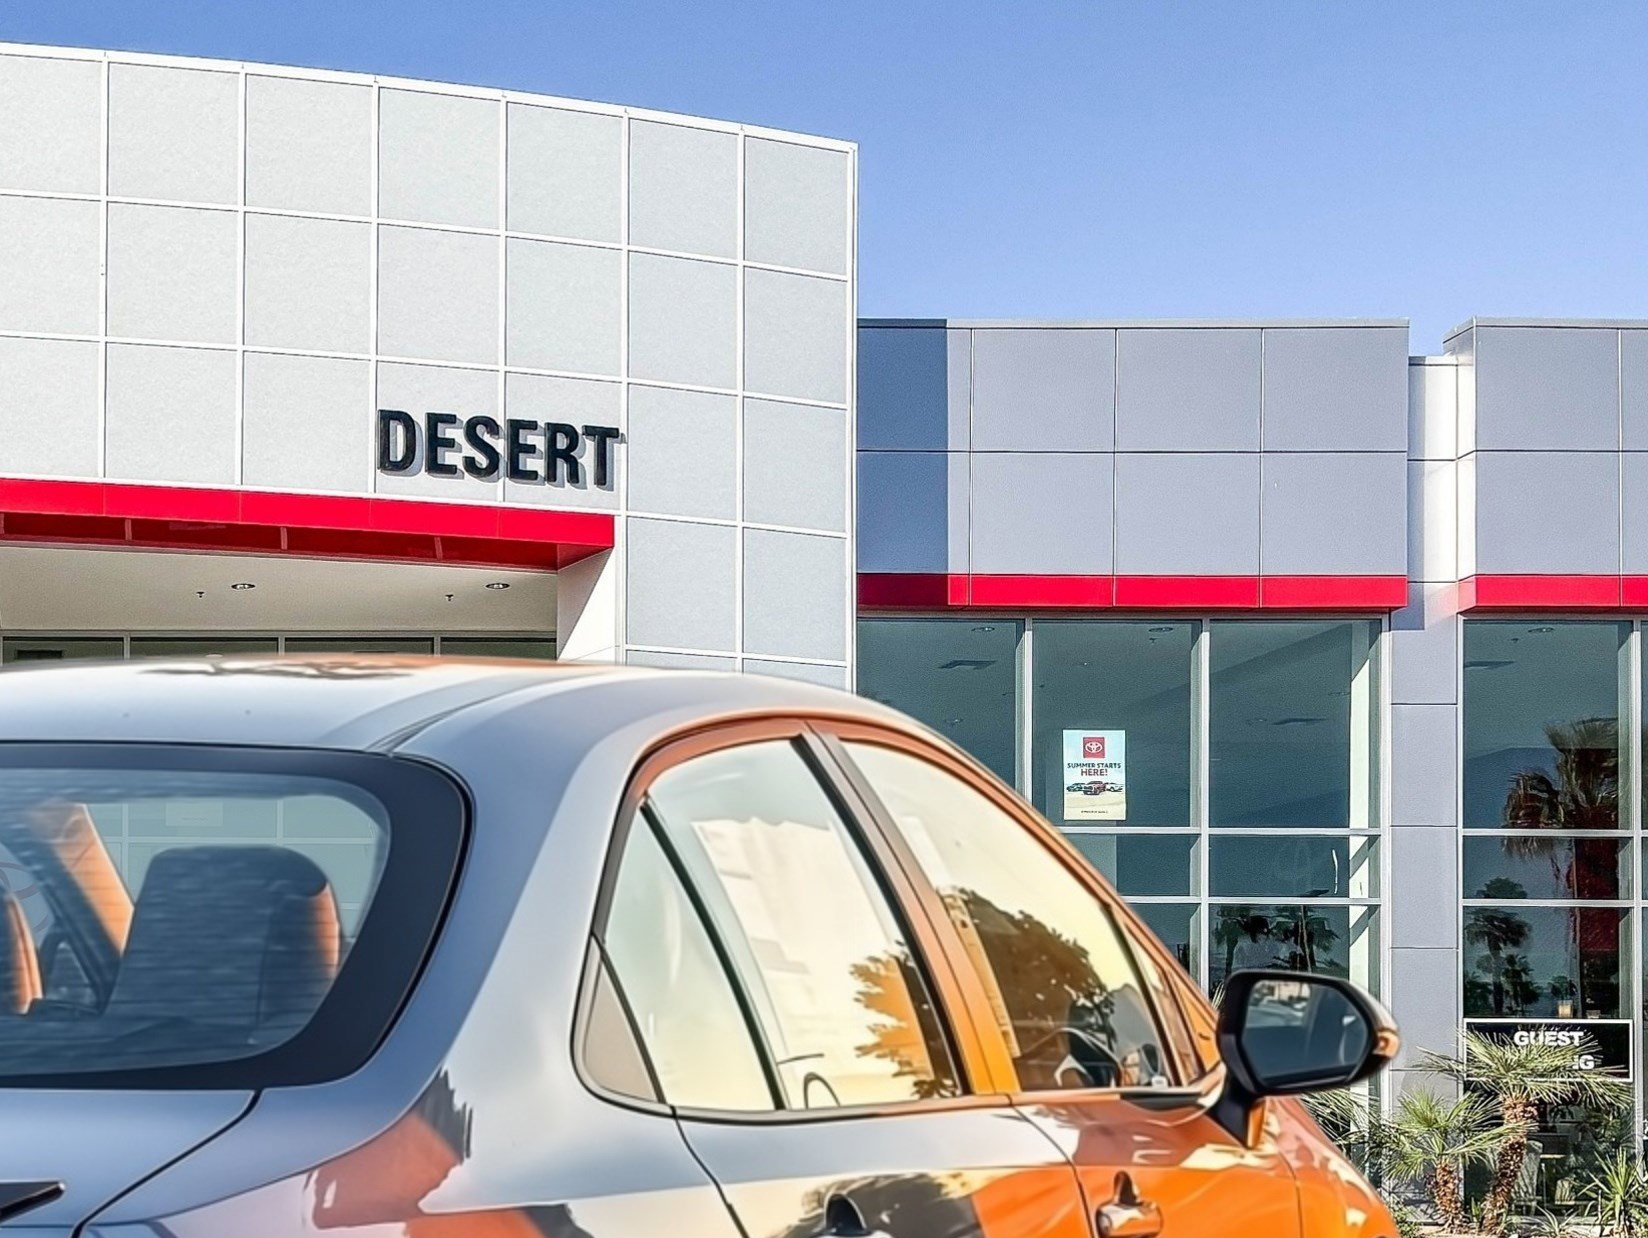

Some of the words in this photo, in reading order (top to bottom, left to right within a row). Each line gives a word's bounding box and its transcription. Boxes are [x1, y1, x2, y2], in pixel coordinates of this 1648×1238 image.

[377, 409, 620, 487] DESERT
[1081, 768, 1108, 776] HERE!
[1514, 1031, 1584, 1047] GUEST
